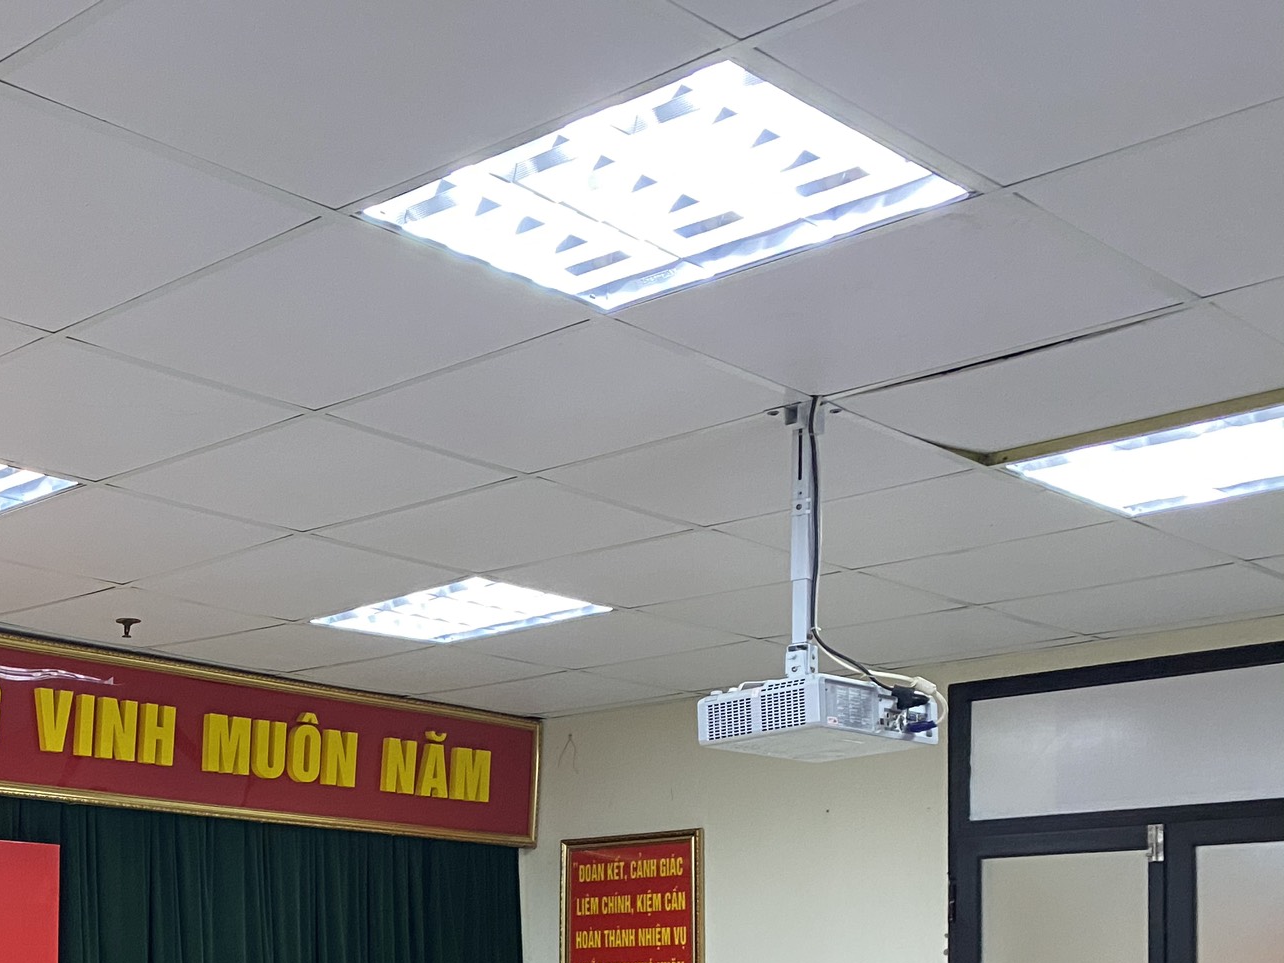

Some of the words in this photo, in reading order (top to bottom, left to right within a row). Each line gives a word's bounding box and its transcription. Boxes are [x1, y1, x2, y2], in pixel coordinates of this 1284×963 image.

[35, 686, 178, 767] VINH
[200, 711, 359, 788] MUÔN
[380, 731, 491, 803] NĂM
[630, 852, 657, 879] CẢNH
[659, 853, 683, 877] GIÁC
[576, 893, 599, 916] LIÊM
[601, 891, 634, 915] CHÍNH,
[636, 889, 662, 917] KIỆM
[576, 926, 601, 949] HOÀN
[604, 925, 636, 948] THÀNH
[638, 923, 671, 950] NHIỆM
[673, 926, 687, 950] VỤ
